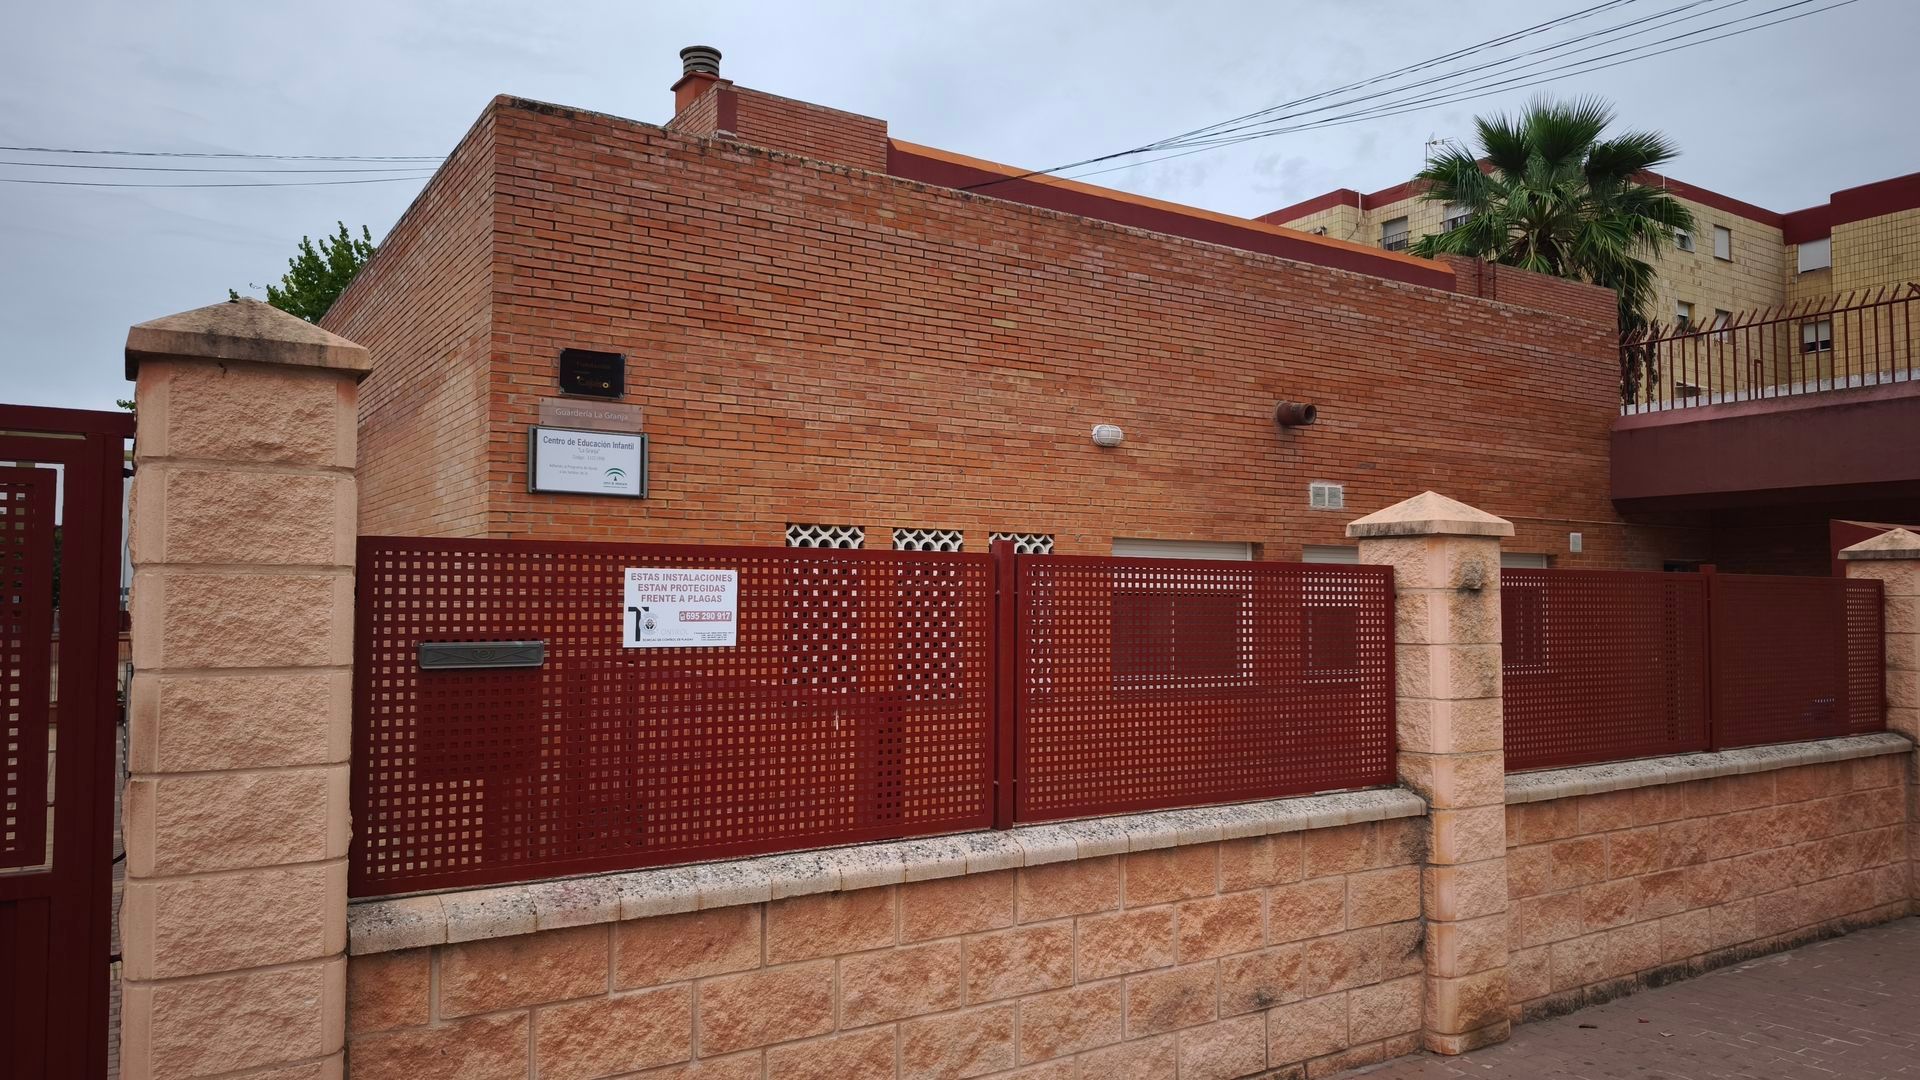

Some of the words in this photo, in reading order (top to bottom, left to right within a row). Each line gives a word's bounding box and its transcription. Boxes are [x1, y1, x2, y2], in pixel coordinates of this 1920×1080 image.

[605, 411, 629, 422] Granja
[543, 436, 565, 446] Centro
[567, 438, 576, 446] de
[577, 438, 611, 449] Educación
[612, 442, 634, 451] Infantil
[631, 573, 660, 581] ESTAS
[663, 573, 733, 582] INSTALACIONES
[638, 584, 668, 592] ESTAN
[670, 584, 726, 592] PROTEGIDAS
[641, 594, 677, 603] FRENTE
[679, 594, 686, 602] A
[687, 594, 722, 603] PLAGAS
[686, 612, 700, 620] 695
[716, 612, 731, 620] 917
